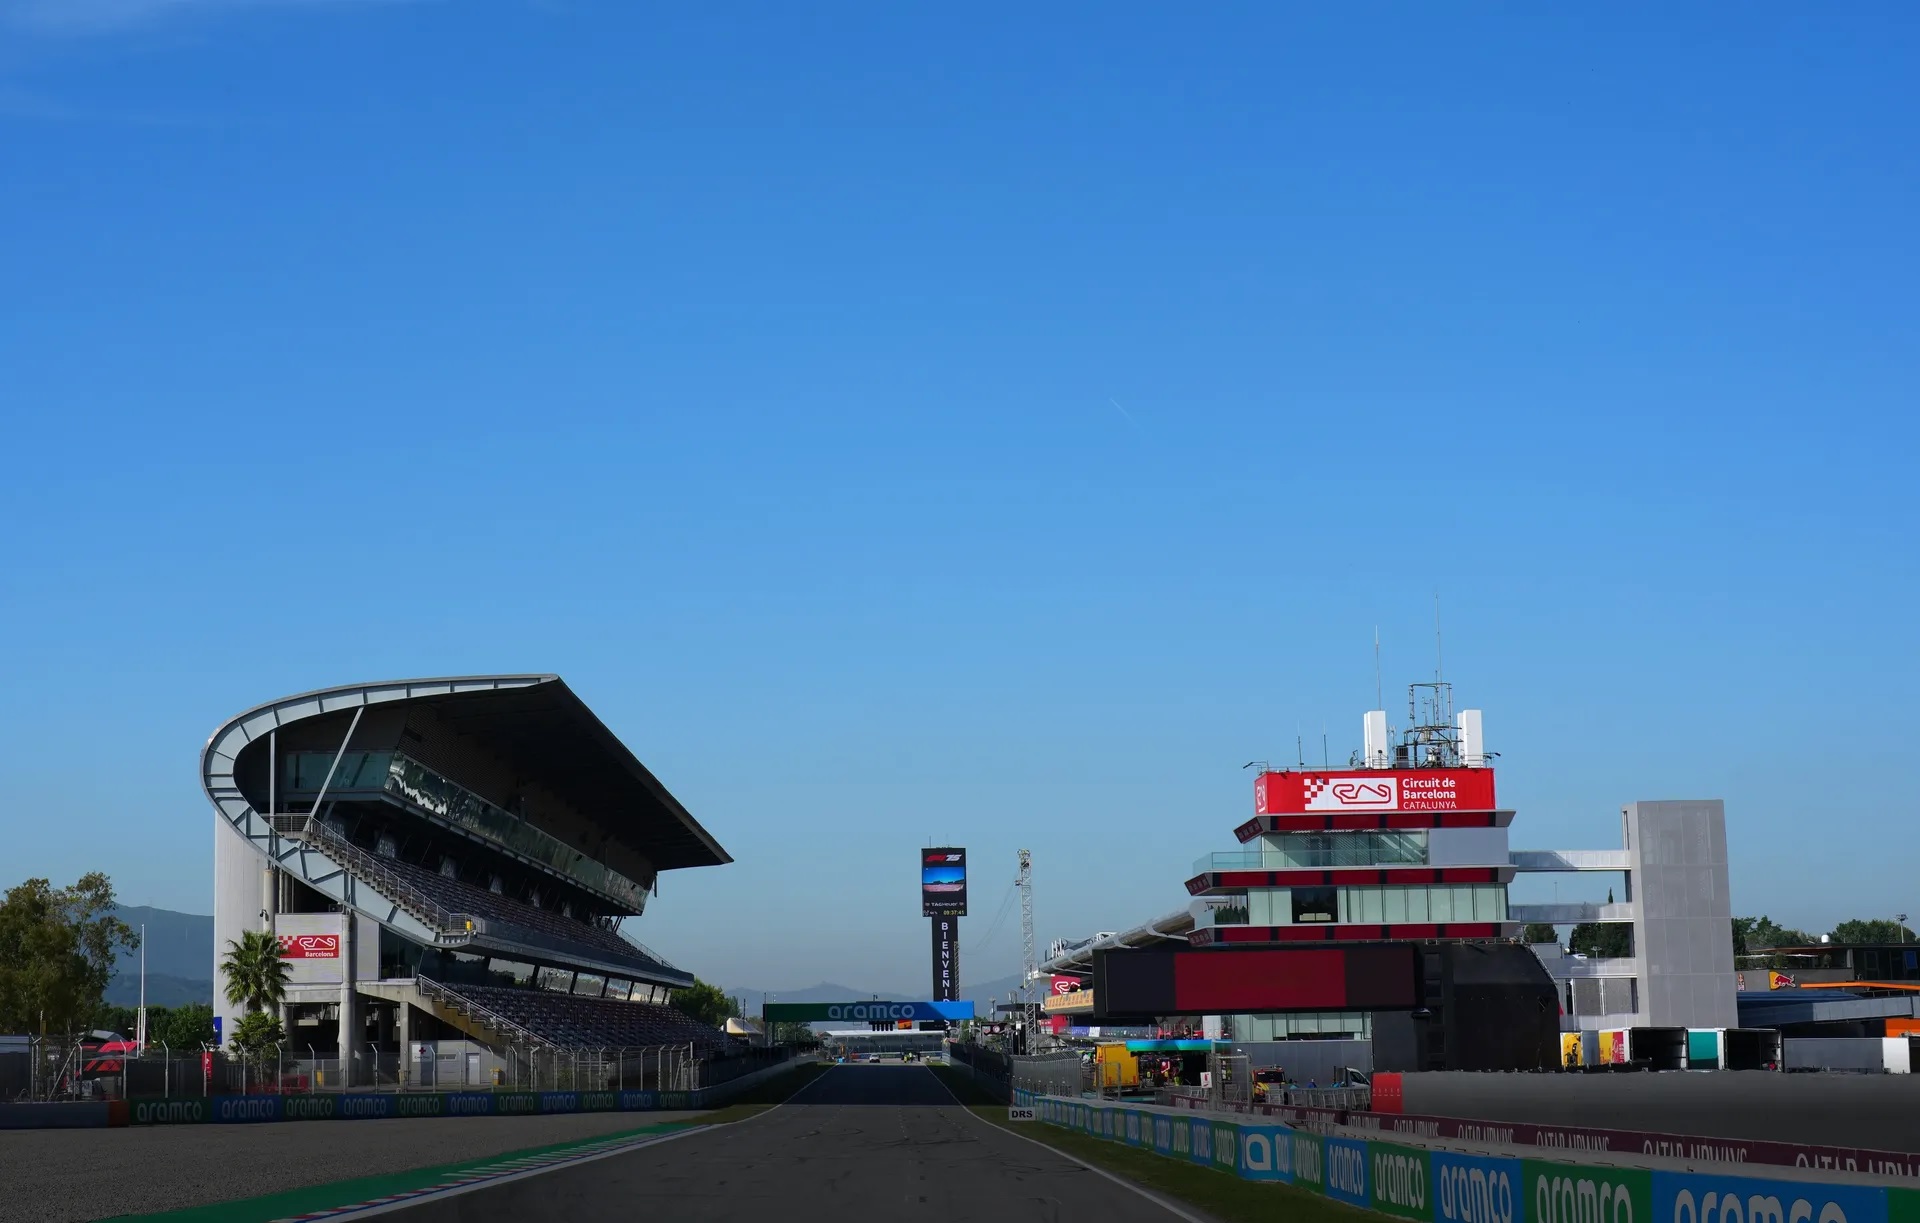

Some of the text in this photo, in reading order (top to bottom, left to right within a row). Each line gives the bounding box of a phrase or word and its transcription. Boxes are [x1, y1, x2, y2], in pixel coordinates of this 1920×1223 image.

[1402, 777, 1456, 788] Circuit de
[1403, 789, 1456, 799] Barcelona
[1403, 801, 1457, 810] CATALUNYA
[828, 1004, 915, 1019] aramco
[222, 1099, 273, 1119] aramco
[286, 1098, 332, 1116] aramco
[344, 1098, 387, 1115] aramco
[400, 1097, 439, 1114] aramco
[450, 1096, 487, 1112] aramco
[499, 1095, 533, 1111] aramco
[543, 1095, 575, 1110] aramco
[583, 1094, 614, 1109] aramco
[623, 1093, 652, 1109] aramco
[660, 1094, 686, 1108] aramco
[137, 1101, 202, 1121] aramco
[1012, 1110, 1032, 1118] DRS
[1295, 1137, 1320, 1185] aramco
[1329, 1144, 1364, 1197] aramco
[1375, 1152, 1425, 1210] aramco
[1440, 1164, 1512, 1223] aramco
